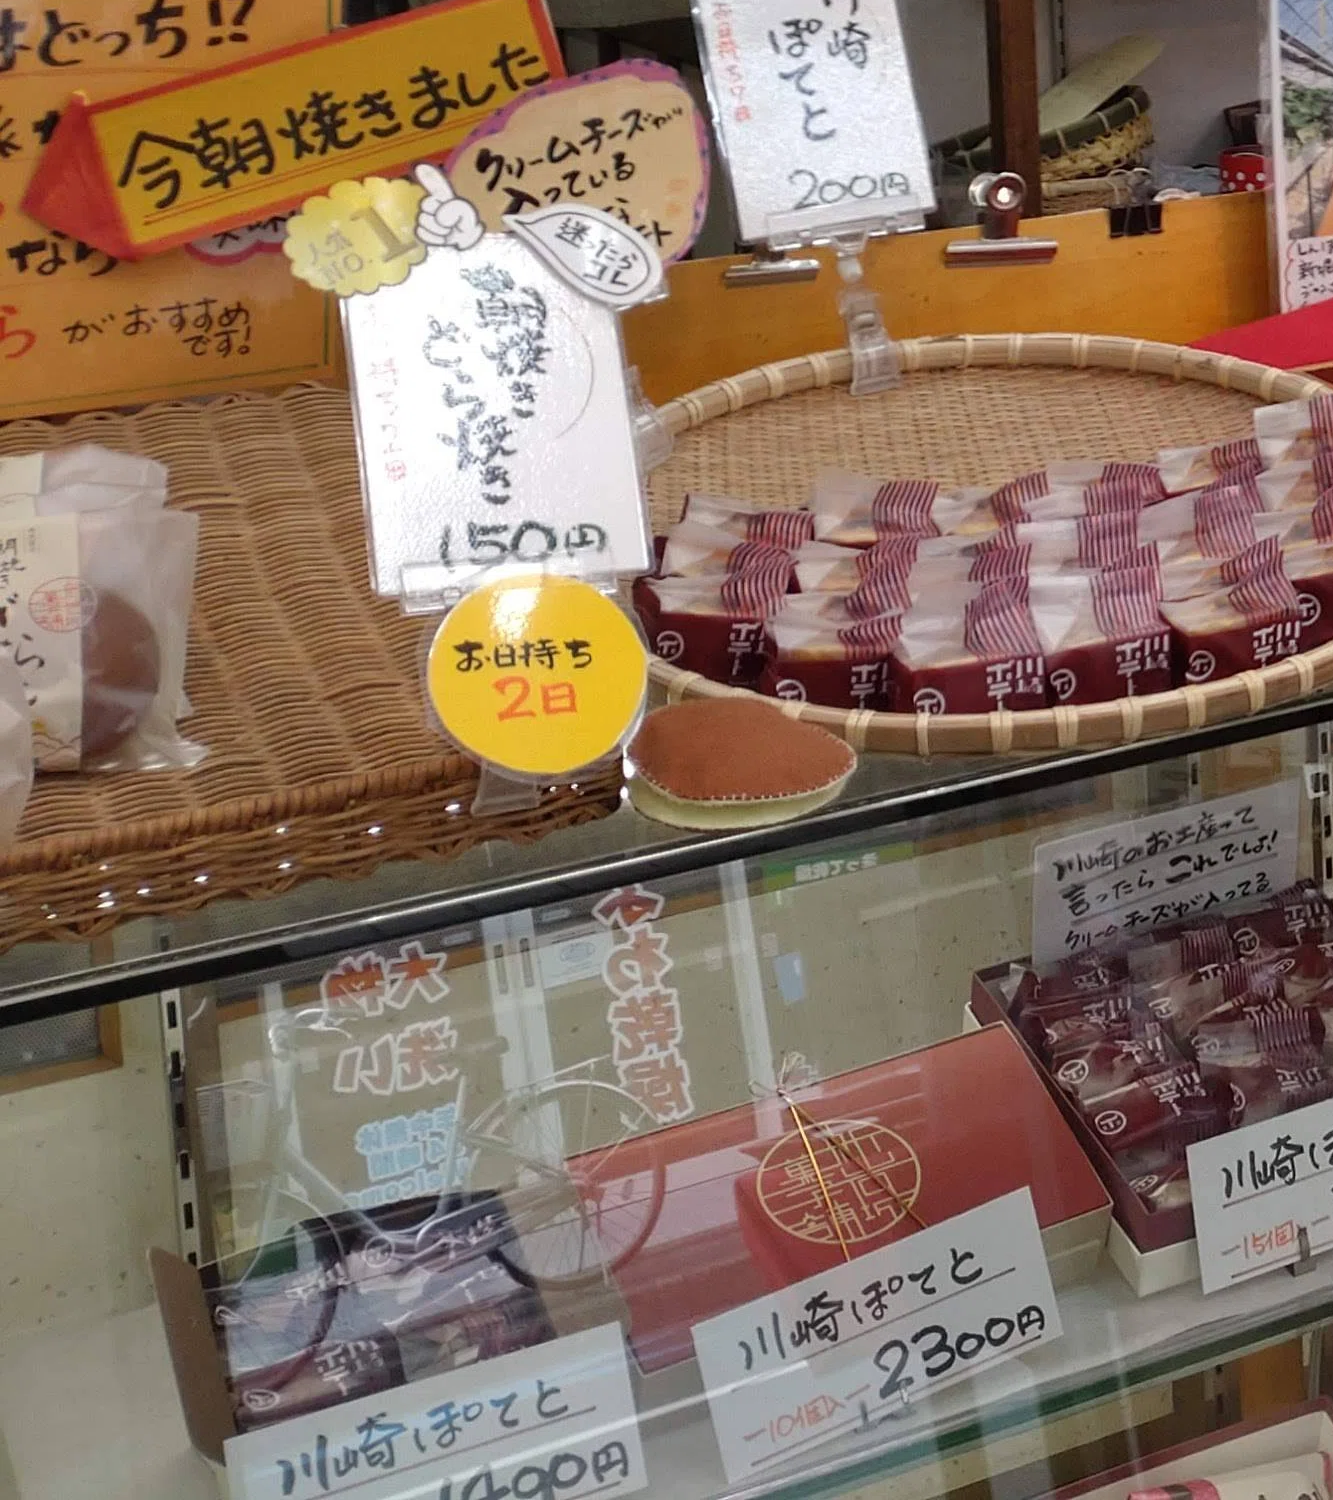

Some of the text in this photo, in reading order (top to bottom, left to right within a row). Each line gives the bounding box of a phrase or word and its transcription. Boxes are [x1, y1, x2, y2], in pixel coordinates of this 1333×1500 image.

[767, 18, 838, 142] ぽてと
[117, 41, 551, 210] 今朝焼きました
[476, 107, 684, 191] クリームチーズが
[502, 151, 635, 215] 入っている
[789, 168, 911, 210] 200円
[555, 216, 637, 272] 迷ったら
[584, 258, 629, 288] コレ
[439, 519, 608, 573] 150円
[494, 675, 580, 723] 2日
[1053, 805, 1258, 882] 川崎のお土産って
[1063, 868, 1156, 917] 言ったら
[738, 1243, 985, 1372] 川崎ぽてと
[873, 1304, 1048, 1400] 2300円
[276, 1378, 570, 1498] 川崎ぽてと
